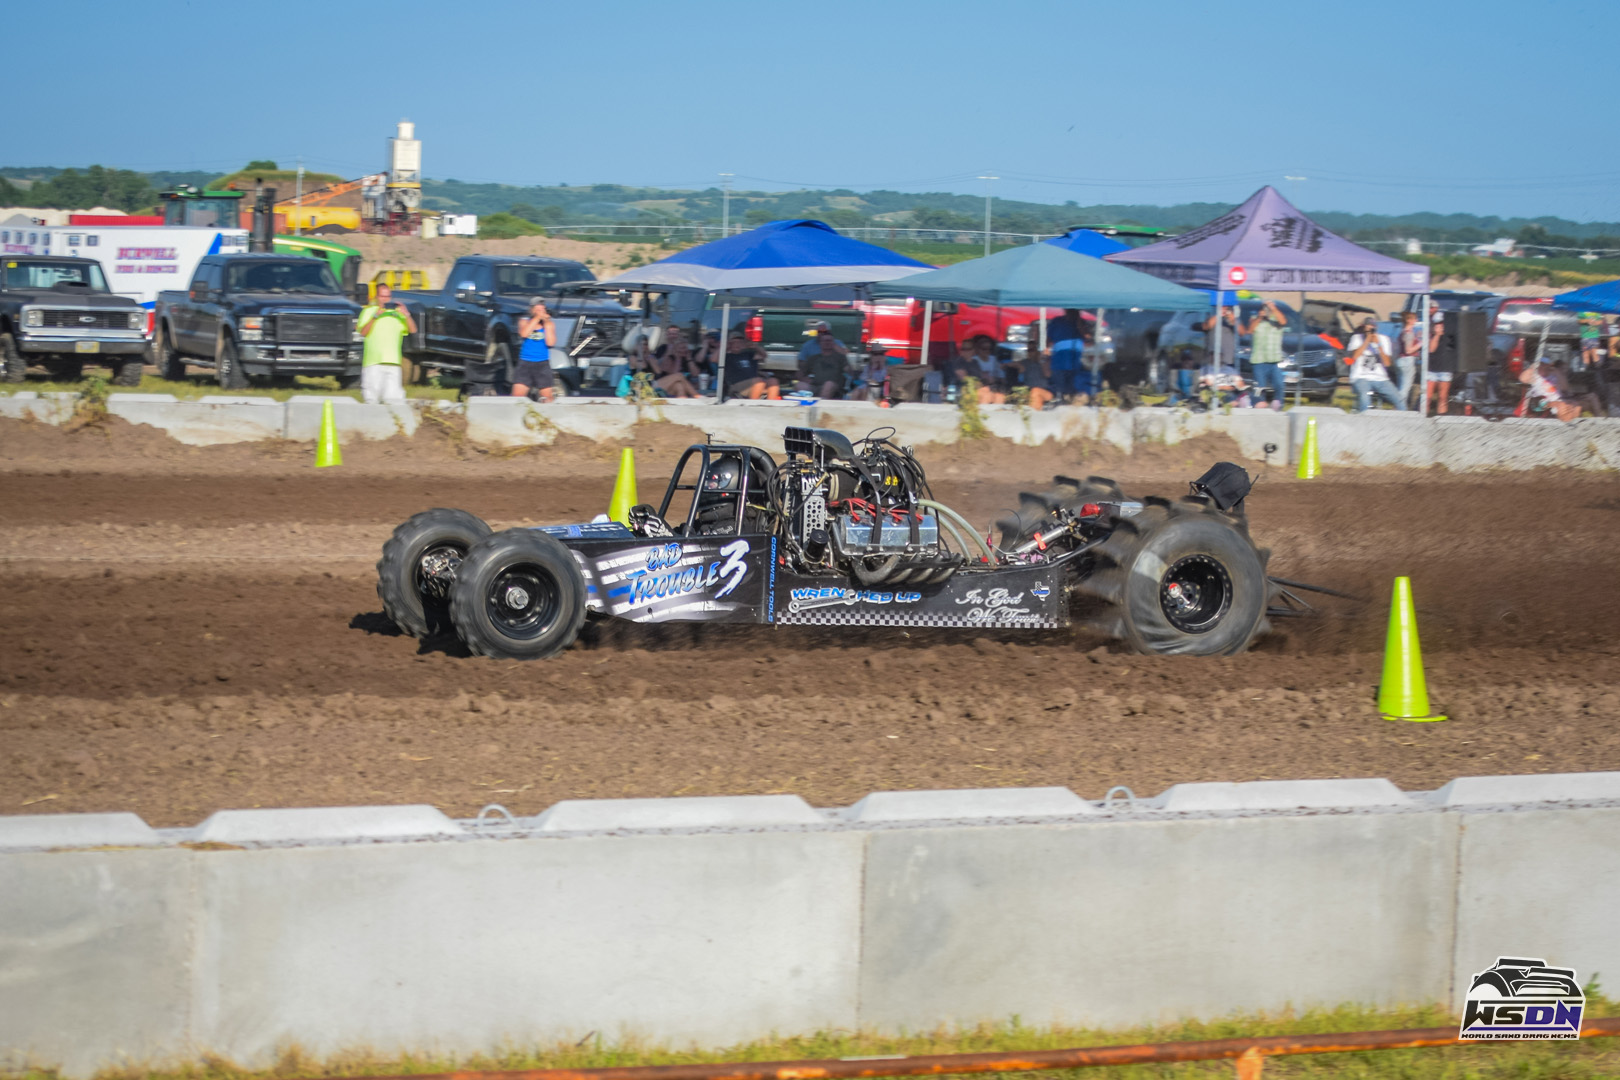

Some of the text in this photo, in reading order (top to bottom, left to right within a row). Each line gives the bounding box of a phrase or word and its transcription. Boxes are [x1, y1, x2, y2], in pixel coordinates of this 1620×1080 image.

[645, 542, 684, 571] BAD
[714, 538, 751, 599] 3
[769, 536, 777, 589] CORNWELL
[895, 591, 922, 603] UP
[955, 587, 1025, 608] In God
[966, 606, 998, 624] We
